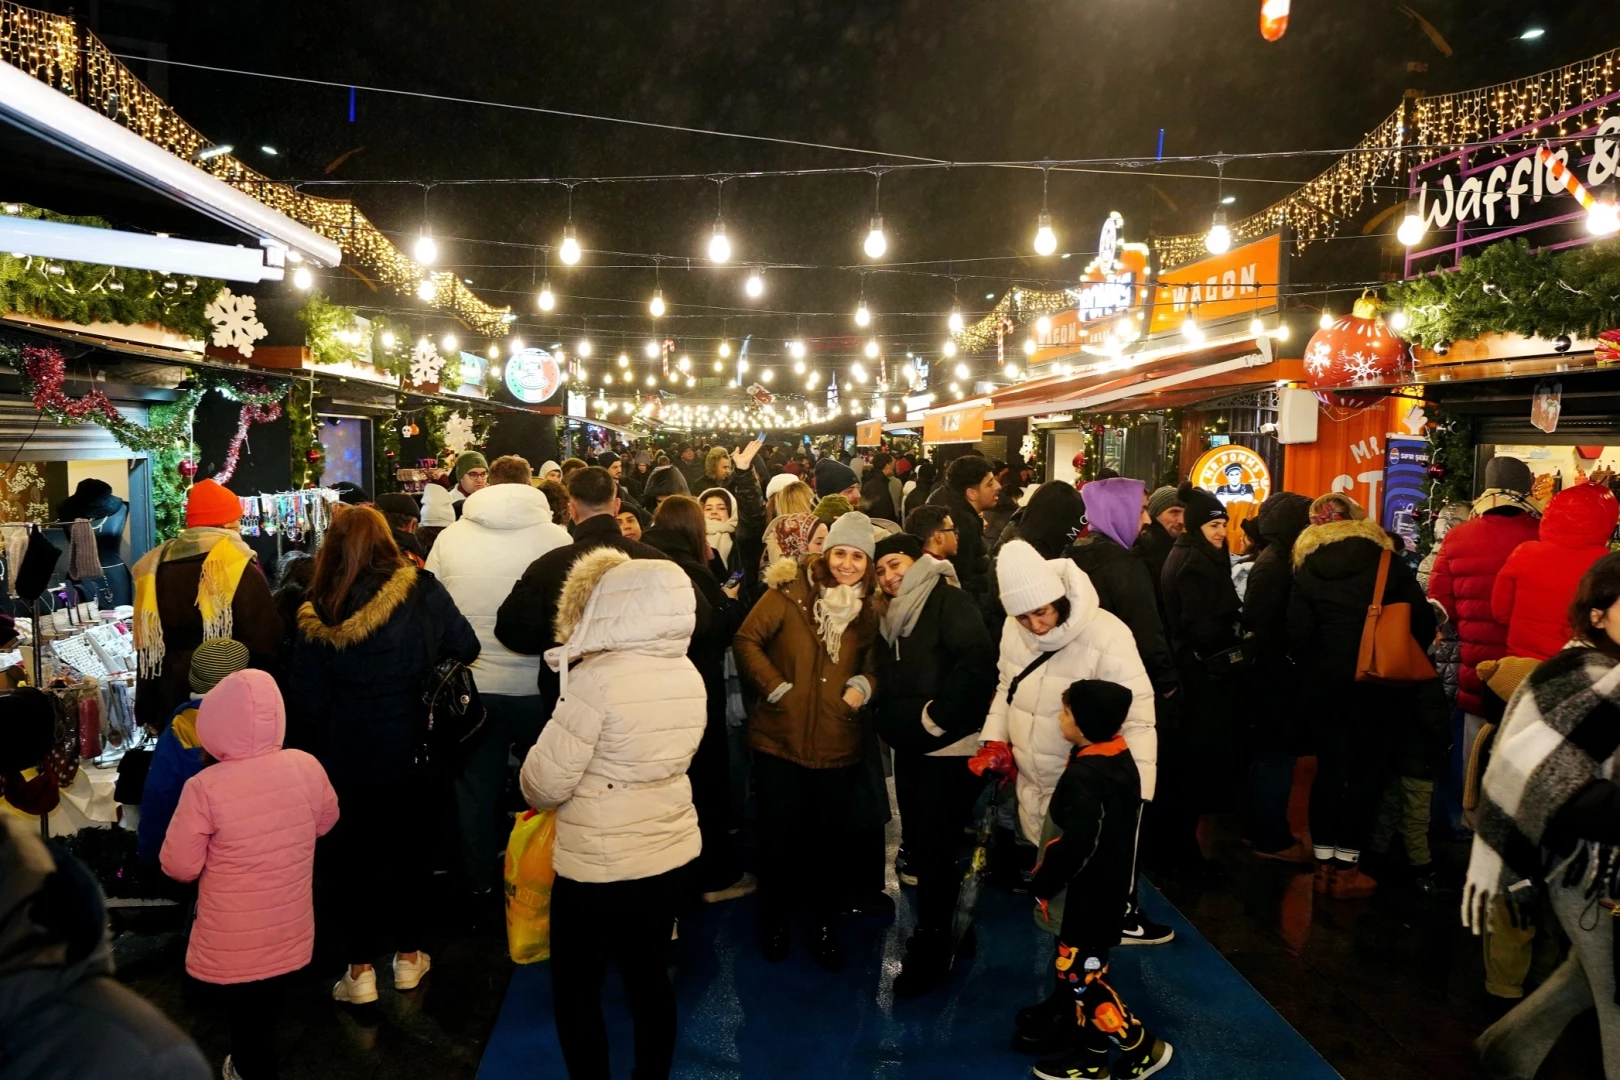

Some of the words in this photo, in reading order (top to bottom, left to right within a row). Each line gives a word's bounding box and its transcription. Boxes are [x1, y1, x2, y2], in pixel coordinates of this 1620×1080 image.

[1419, 145, 1569, 234] Waffle
[1172, 263, 1258, 313] WAGON
[1350, 436, 1385, 464] MR.
